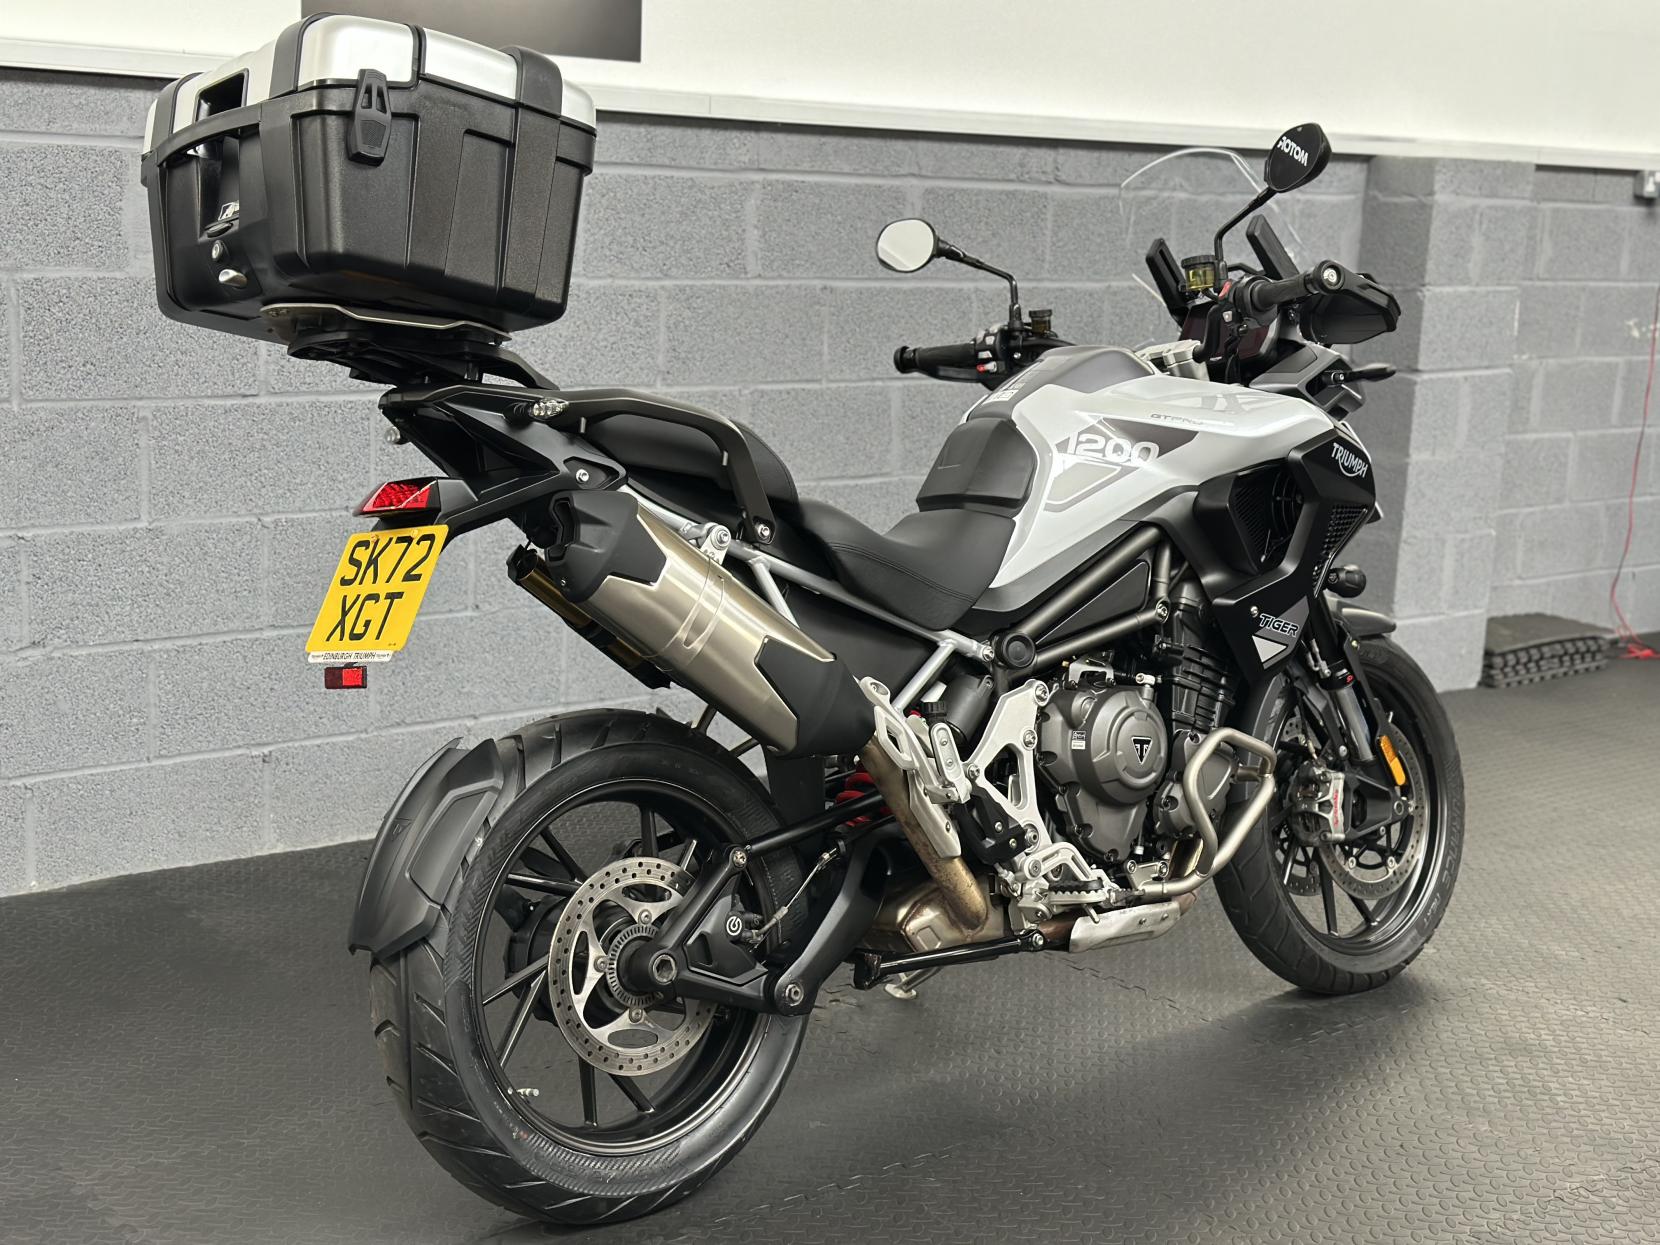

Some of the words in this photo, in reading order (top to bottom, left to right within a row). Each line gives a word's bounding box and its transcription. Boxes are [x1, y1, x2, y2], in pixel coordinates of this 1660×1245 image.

[1066, 431, 1160, 465] 1200
[1331, 443, 1368, 478] TRIUMPH
[340, 533, 436, 586] SK72
[325, 591, 404, 642] XGT
[1259, 613, 1299, 637] TIGER
[353, 651, 376, 660] TRIUMPH
